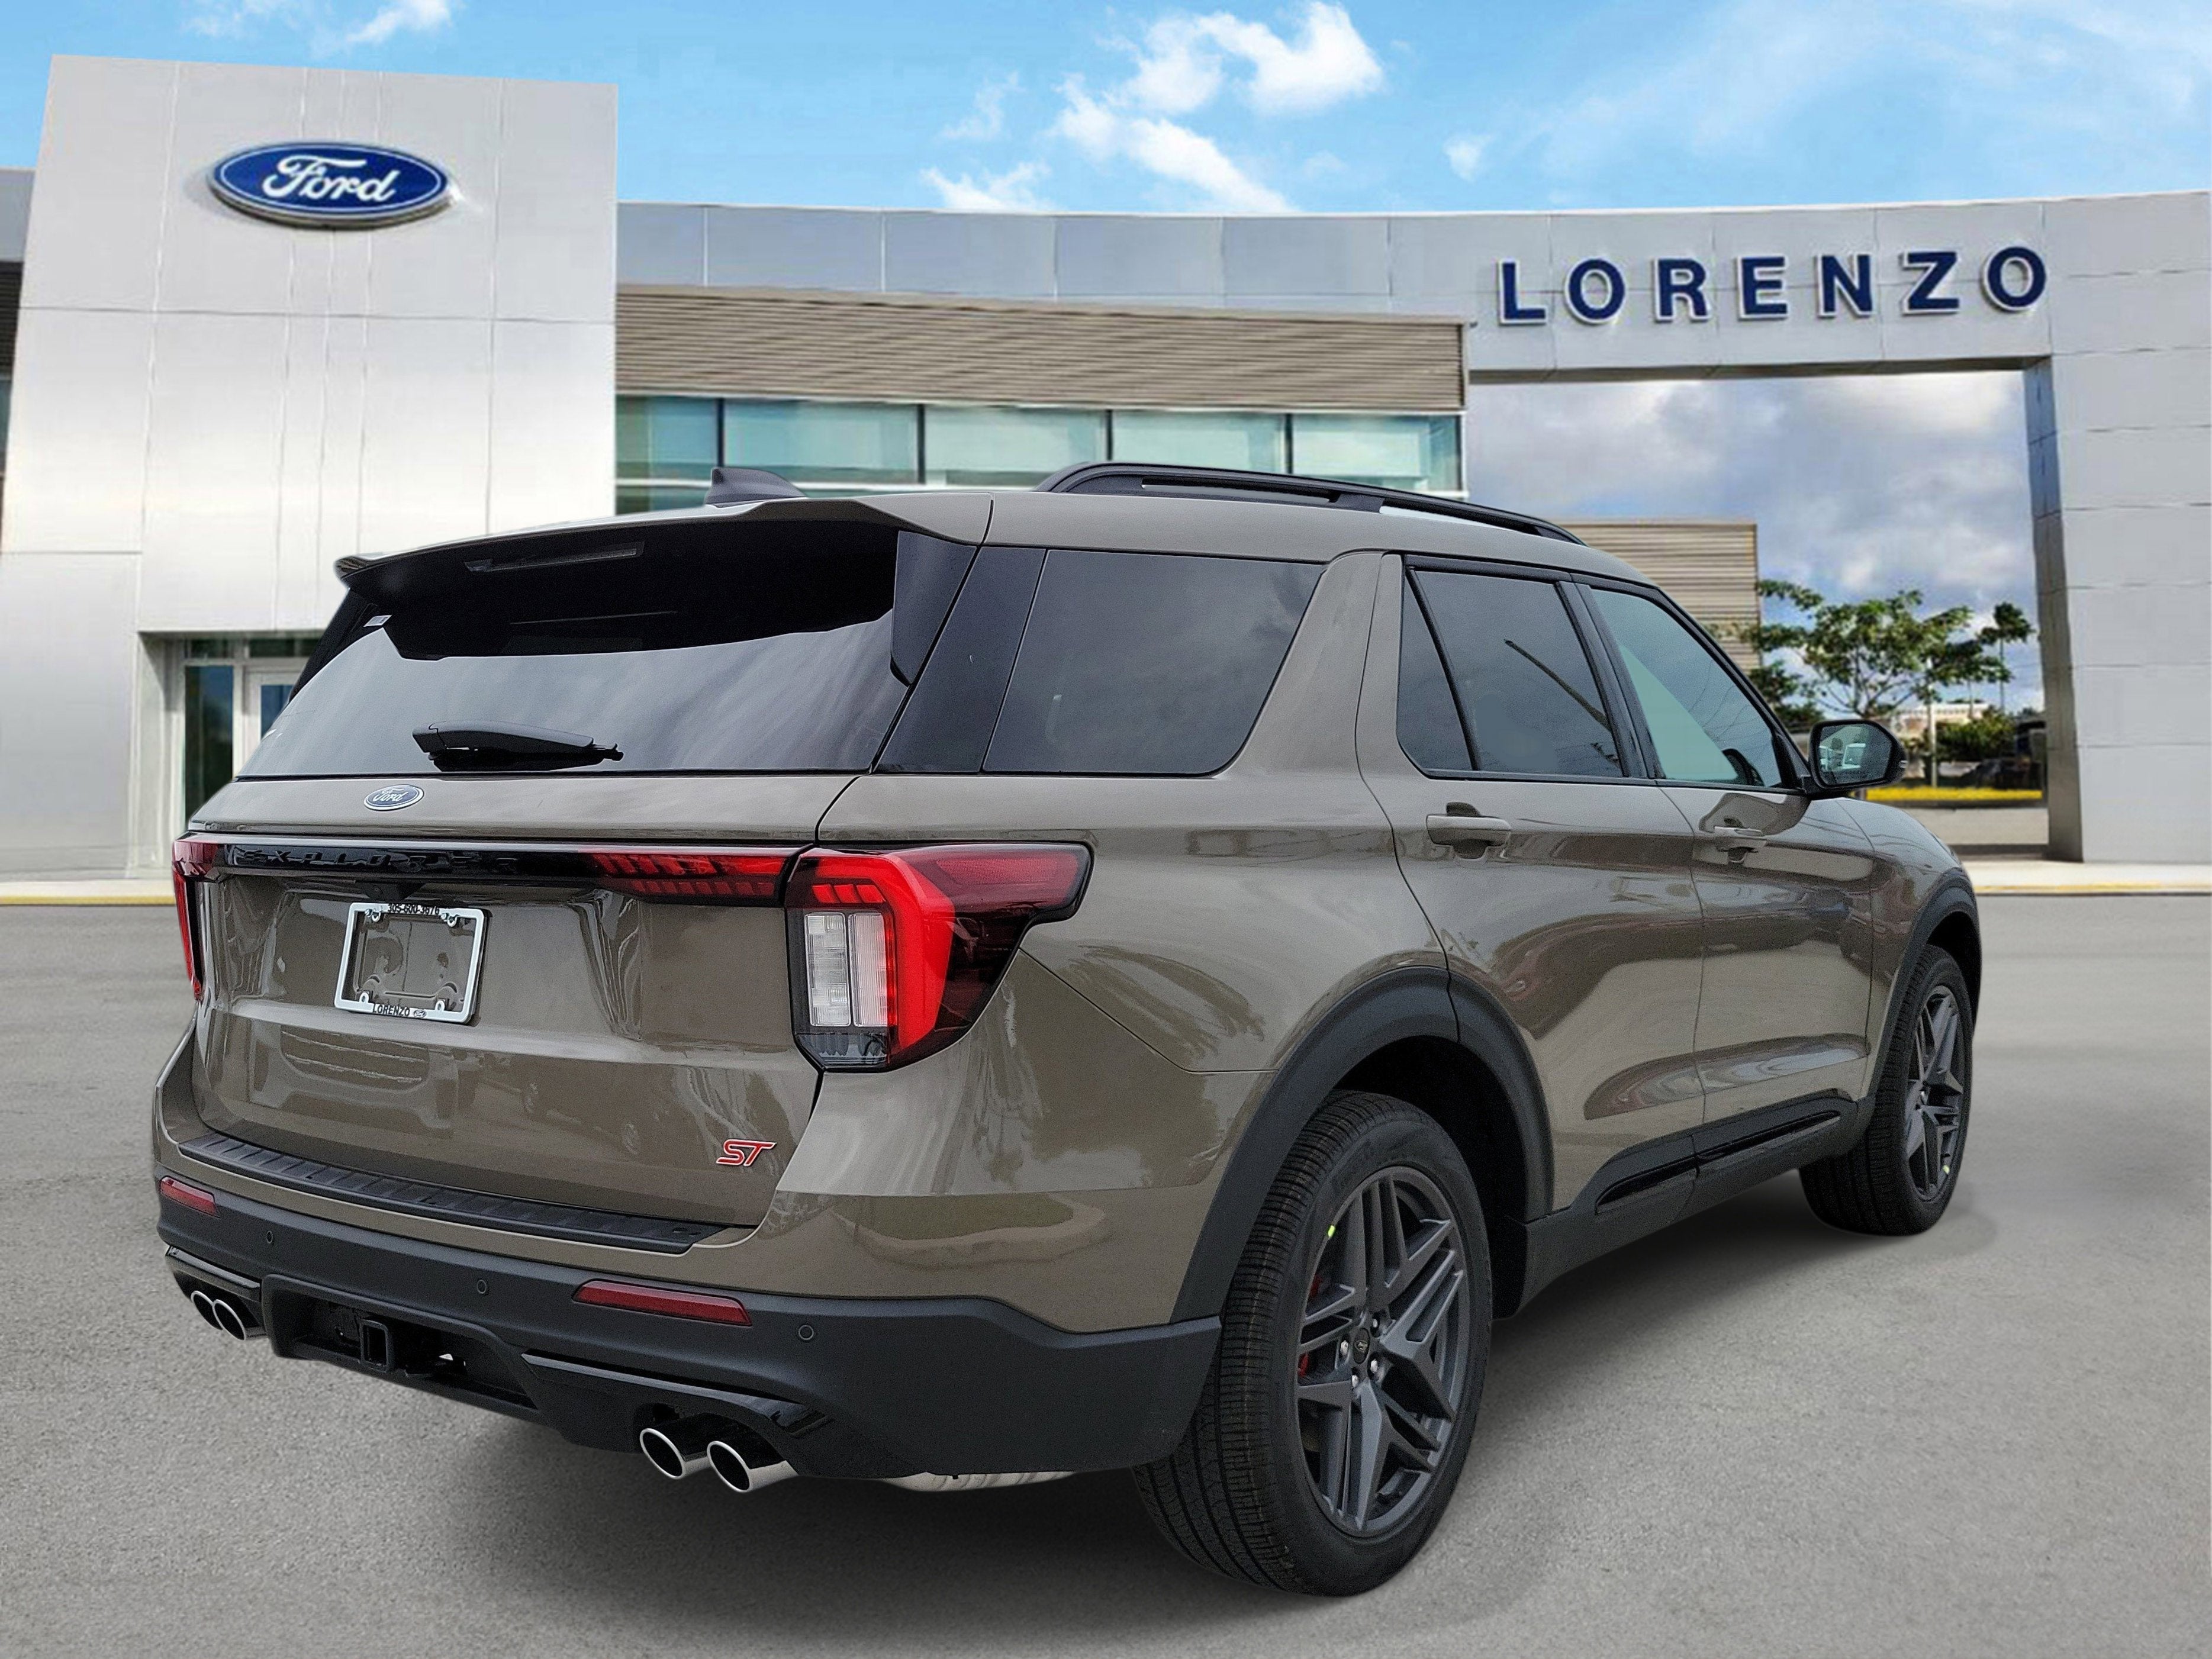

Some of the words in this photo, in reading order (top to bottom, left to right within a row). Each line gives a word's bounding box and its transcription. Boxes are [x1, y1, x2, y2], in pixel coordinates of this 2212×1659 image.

[262, 155, 400, 202] Ford
[1497, 246, 2047, 325] LORENZO
[373, 788, 409, 802] Ford
[372, 1003, 411, 1017] LORENZO
[716, 1139, 777, 1167] ST
